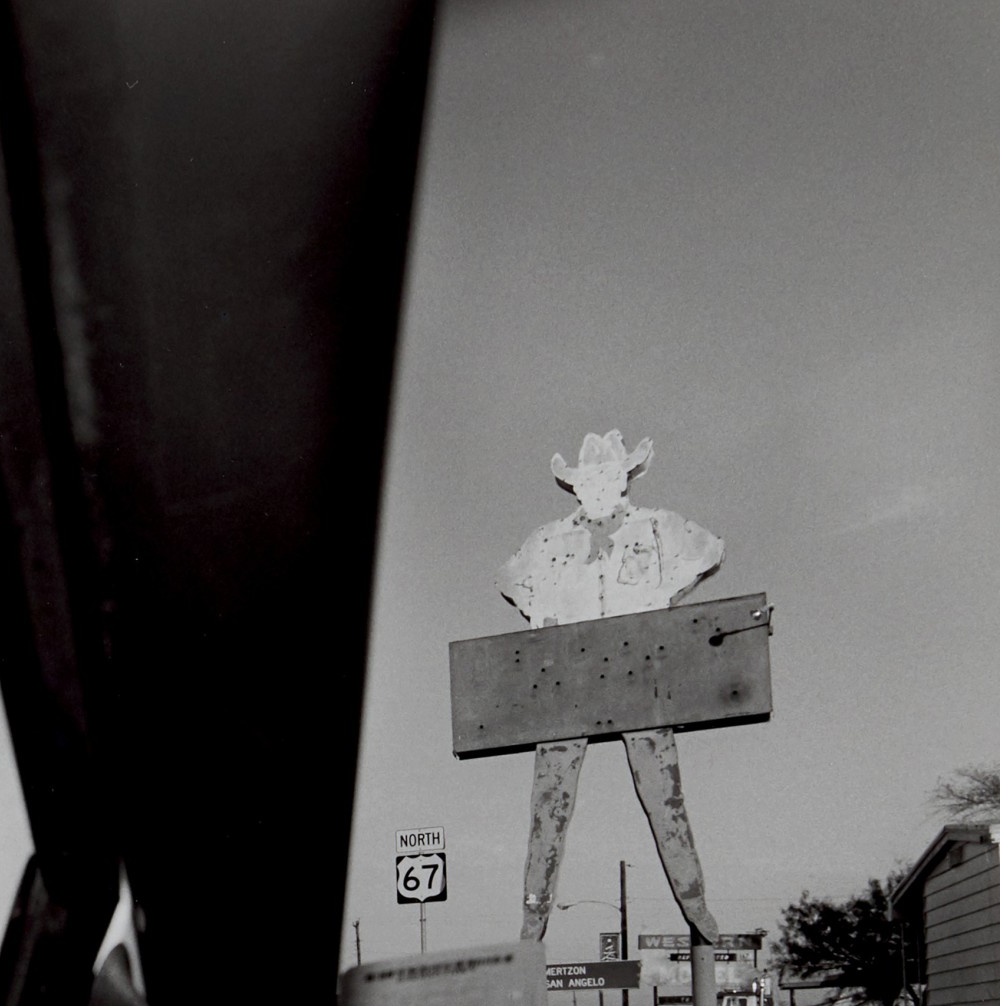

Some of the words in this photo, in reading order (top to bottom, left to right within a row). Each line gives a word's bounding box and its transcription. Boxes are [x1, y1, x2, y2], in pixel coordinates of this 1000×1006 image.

[400, 832, 440, 848] NORTH
[403, 864, 439, 891] 67
[568, 977, 605, 988] ANGELO
